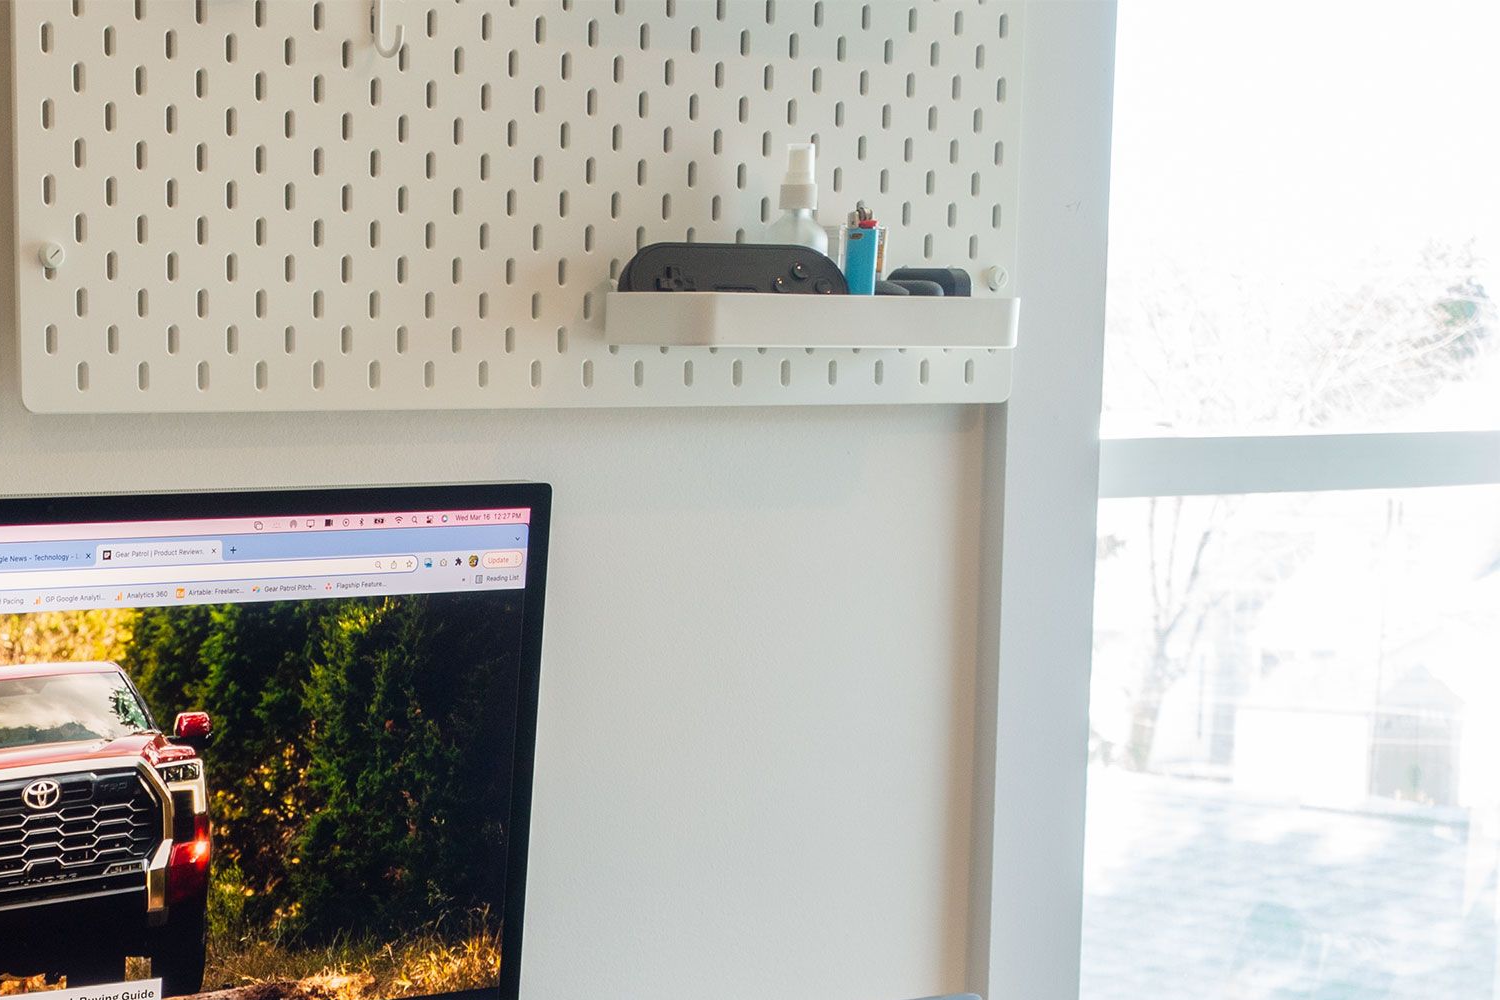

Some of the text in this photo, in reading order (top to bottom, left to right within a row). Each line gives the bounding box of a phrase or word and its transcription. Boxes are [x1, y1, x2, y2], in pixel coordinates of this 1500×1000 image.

[455, 513, 469, 521] Wed
[470, 513, 481, 521] Mar
[494, 512, 511, 520] 12:27
[512, 512, 522, 520] PM
[10, 555, 28, 563] News
[34, 553, 70, 563] Technology
[115, 550, 130, 558] Gear
[131, 550, 150, 558] Patrol
[154, 549, 177, 557] Product
[488, 556, 509, 565] Update
[486, 574, 508, 583] Reading
[264, 585, 278, 593] Gear
[279, 584, 297, 592] Patrol
[336, 582, 361, 590] Flagship
[56, 595, 78, 603] Google
[126, 590, 168, 600] Analytics 360
[2, 597, 25, 607] Pacing
